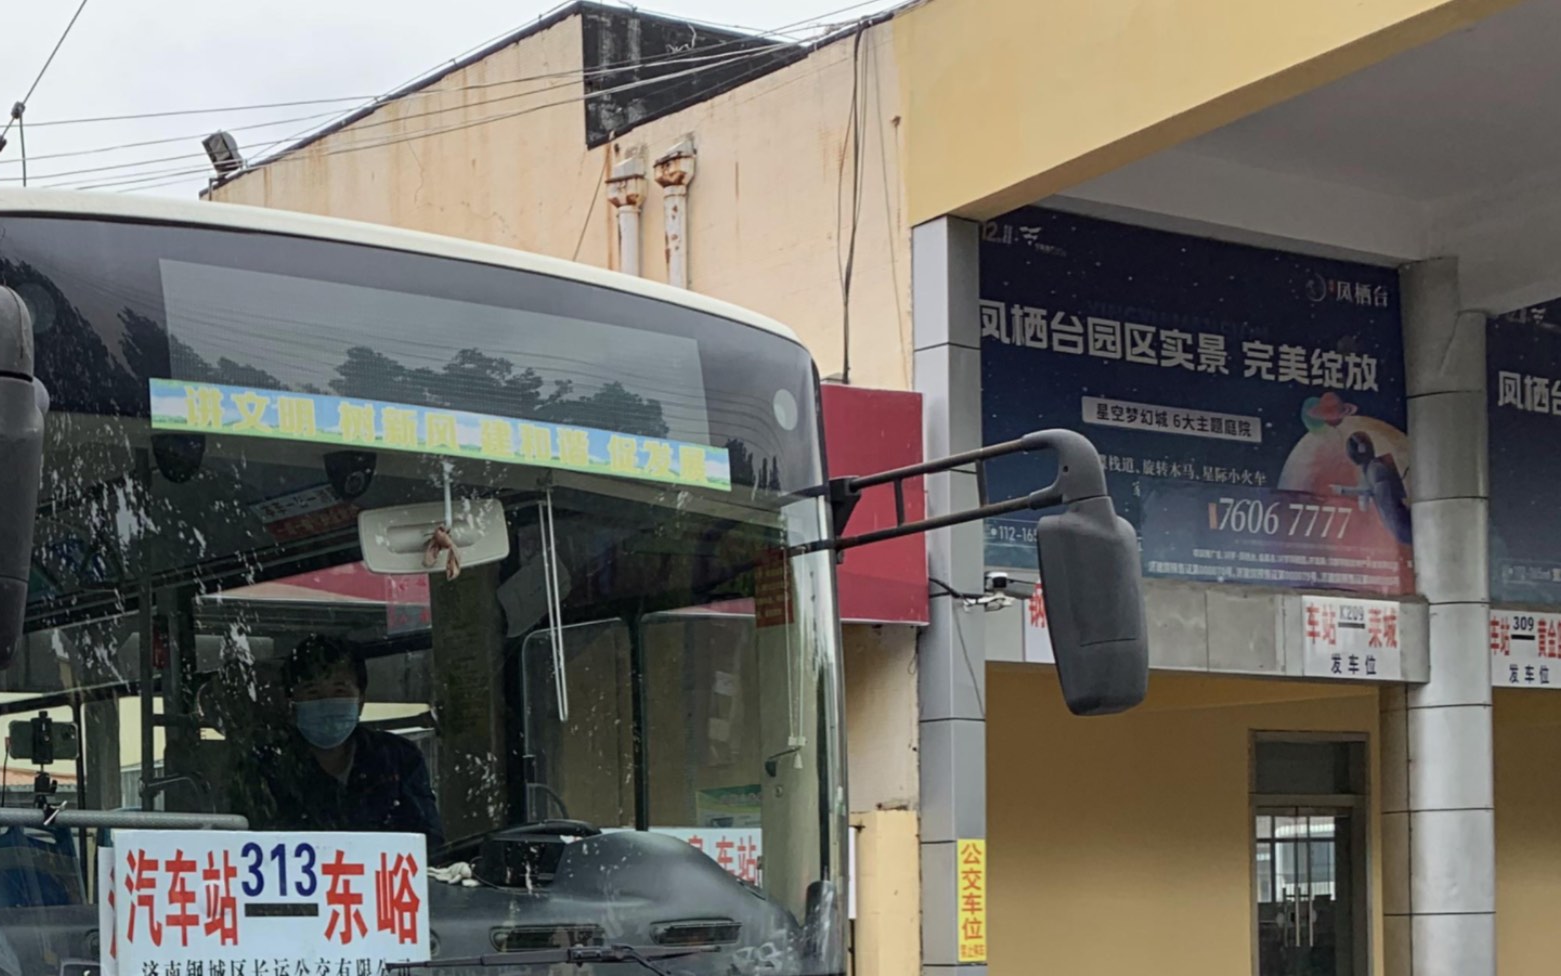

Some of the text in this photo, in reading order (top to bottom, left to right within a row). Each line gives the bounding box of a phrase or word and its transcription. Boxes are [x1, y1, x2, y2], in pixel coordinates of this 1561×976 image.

[980, 299, 1230, 376] 凤栖台园区实景
[1243, 340, 1379, 393] 完美绽放
[184, 385, 707, 482] 讲文明 树新风 建和谐 促发展
[1096, 402, 1252, 438] 星空梦幻城 6大主题庭院
[1218, 498, 1353, 539] 7606 7777
[1331, 654, 1377, 676] 发车位
[1513, 616, 1535, 631] 309
[1537, 618, 1561, 659] 黄金
[124, 848, 239, 947] 汽车站
[240, 842, 318, 898] 313
[321, 849, 421, 945] 东峪
[961, 843, 983, 941] 公交车位
